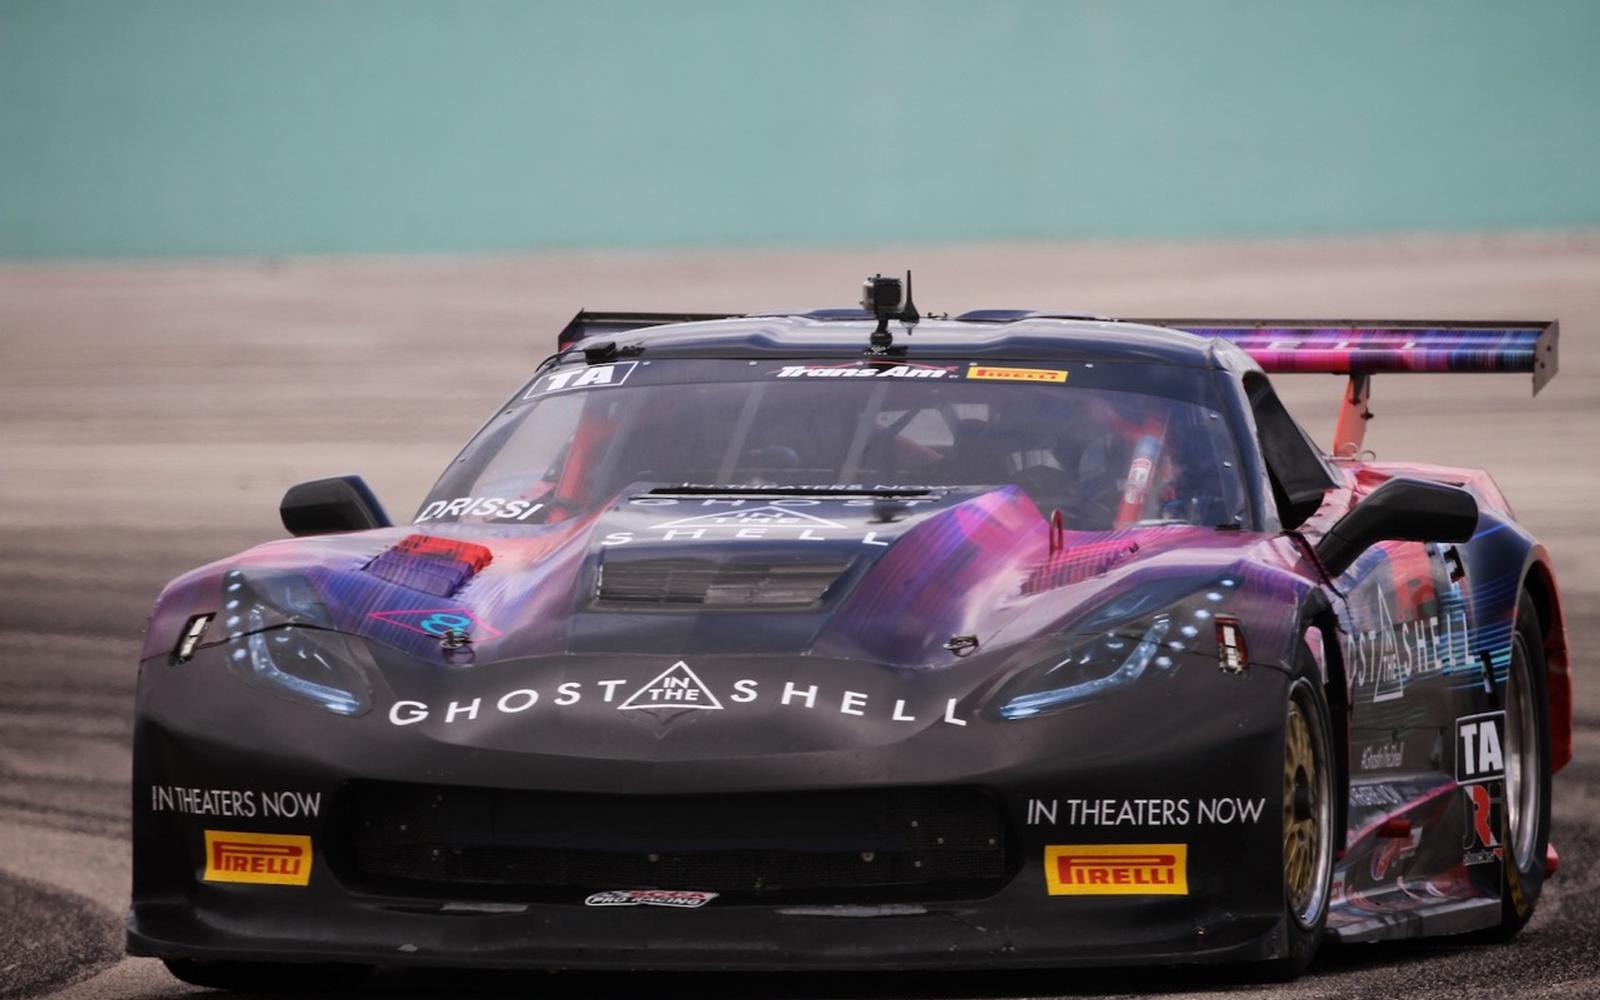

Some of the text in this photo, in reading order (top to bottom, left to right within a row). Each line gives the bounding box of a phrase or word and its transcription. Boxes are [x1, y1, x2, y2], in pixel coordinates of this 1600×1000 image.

[546, 365, 615, 391] TA
[412, 497, 544, 524] DRISSI
[601, 528, 889, 546] SHELL
[1346, 629, 1377, 688] OST
[1402, 612, 1478, 678] SHELL
[648, 688, 700, 701] THE
[663, 676, 690, 689] IN
[388, 679, 627, 726] GHOST
[730, 679, 967, 726] SHELL
[1460, 720, 1504, 775] TA
[152, 784, 321, 818] IN THEATERS NOW
[1027, 798, 1266, 826] IN THEATERS NOW
[212, 840, 304, 875] PIRELLI
[1056, 854, 1177, 885] PIRELLI
